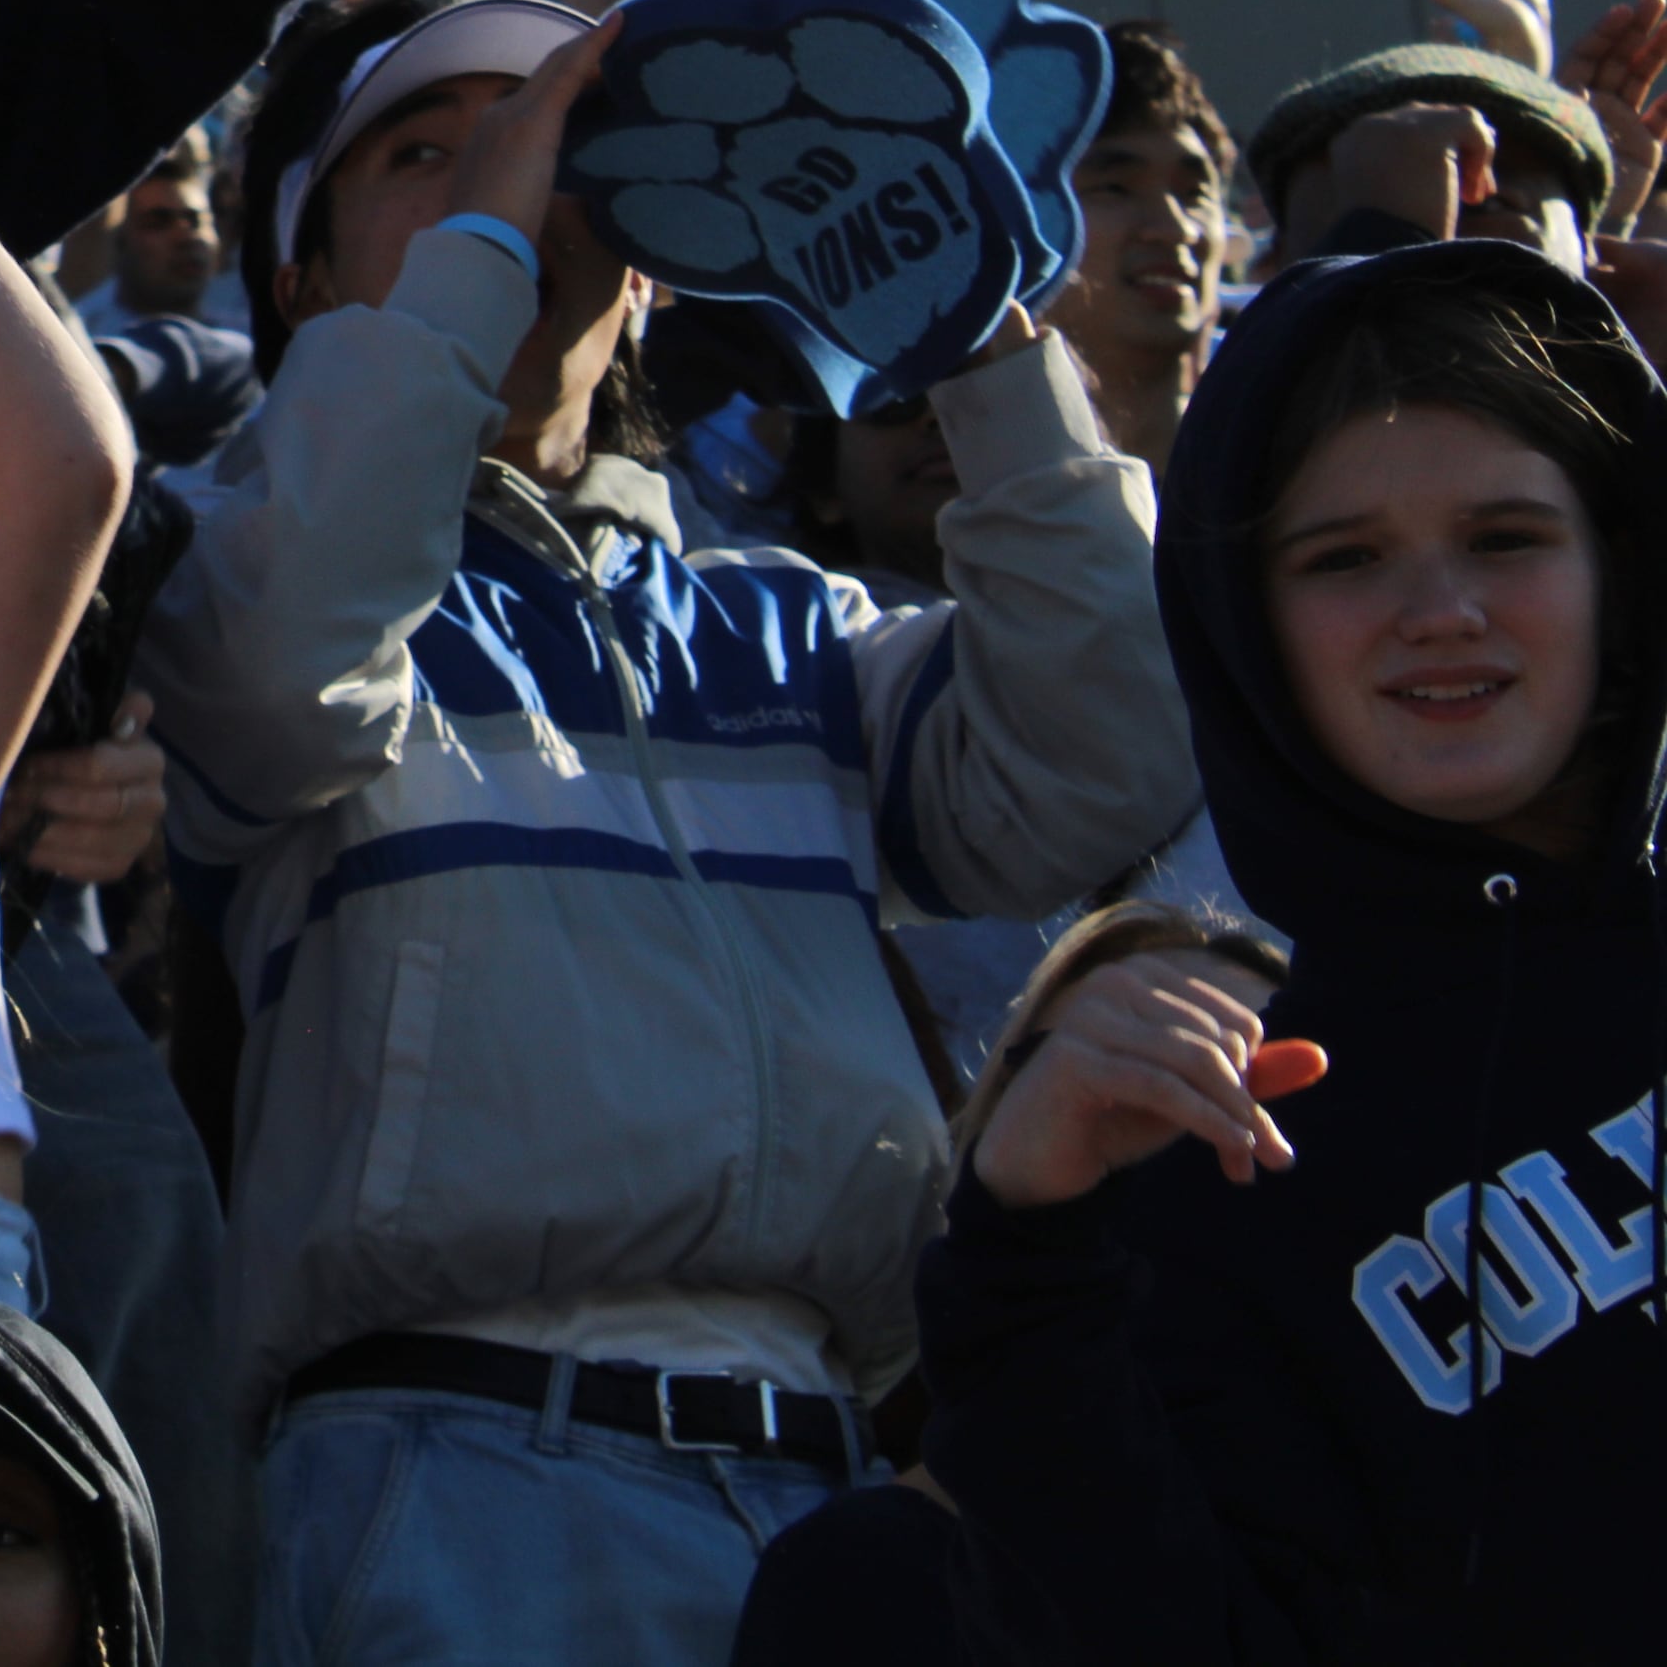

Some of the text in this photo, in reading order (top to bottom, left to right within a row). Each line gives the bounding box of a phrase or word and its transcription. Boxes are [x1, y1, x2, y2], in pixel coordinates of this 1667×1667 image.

[760, 145, 858, 216] GO
[794, 162, 969, 312] IONS!
[1351, 1074, 1667, 1416] COL
